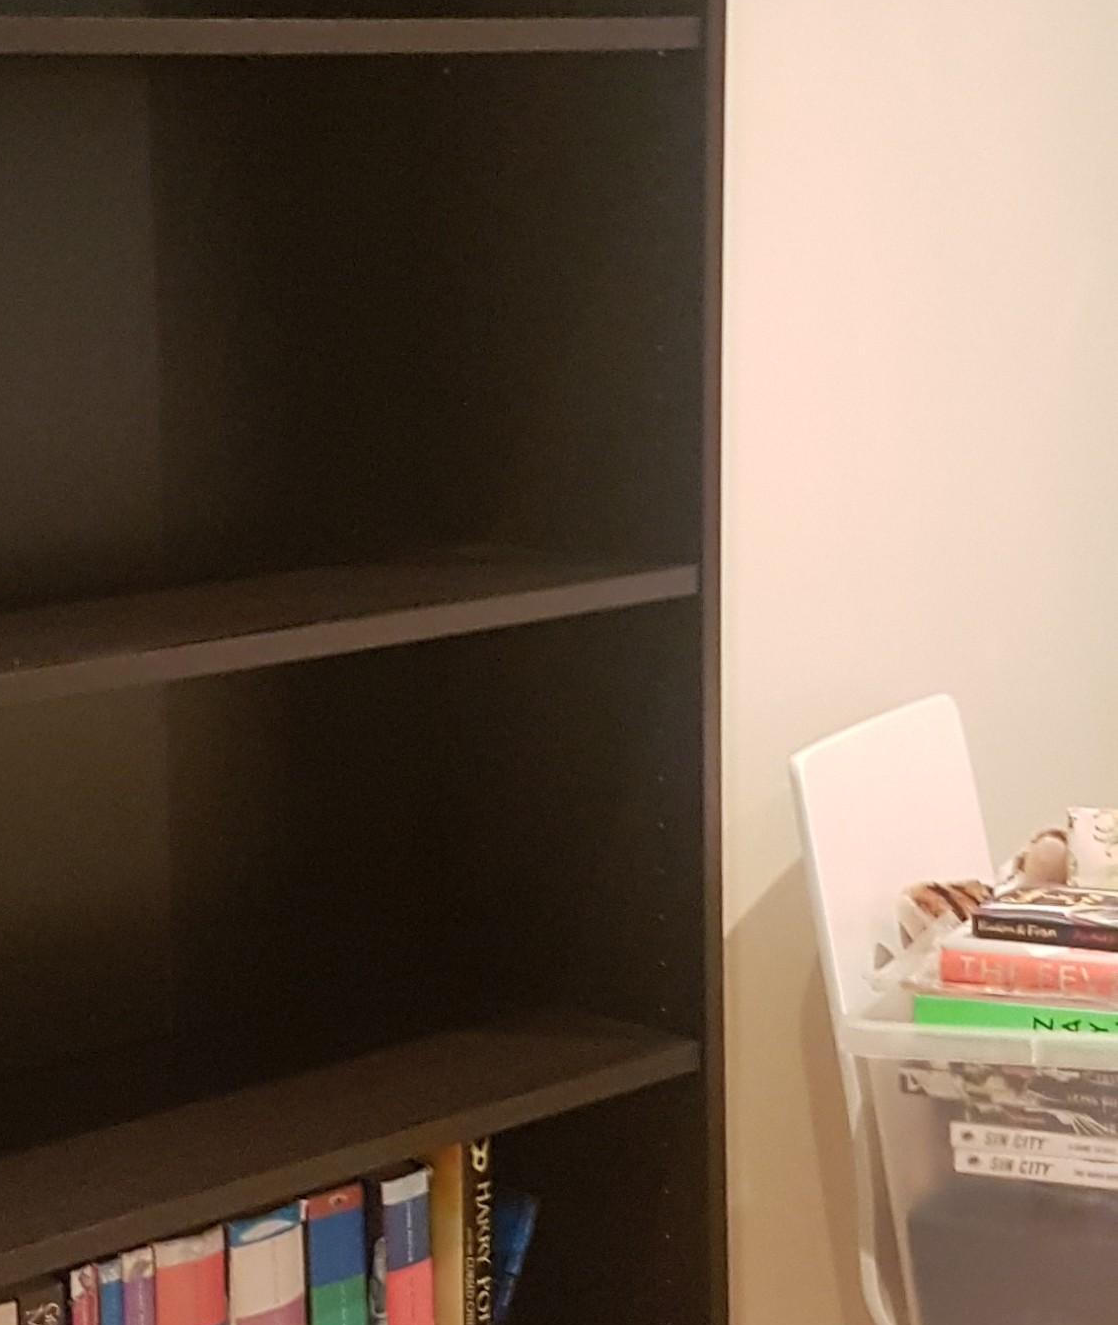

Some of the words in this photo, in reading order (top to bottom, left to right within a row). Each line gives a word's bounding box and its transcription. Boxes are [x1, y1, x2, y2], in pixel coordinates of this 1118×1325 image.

[1033, 1016, 1118, 1032] NAY
[985, 1131, 1008, 1147] SIN
[1013, 1136, 1046, 1151] CITY
[989, 1156, 1014, 1173] SIN
[1019, 1161, 1055, 1177] CITY
[475, 1180, 492, 1265] HARRY
